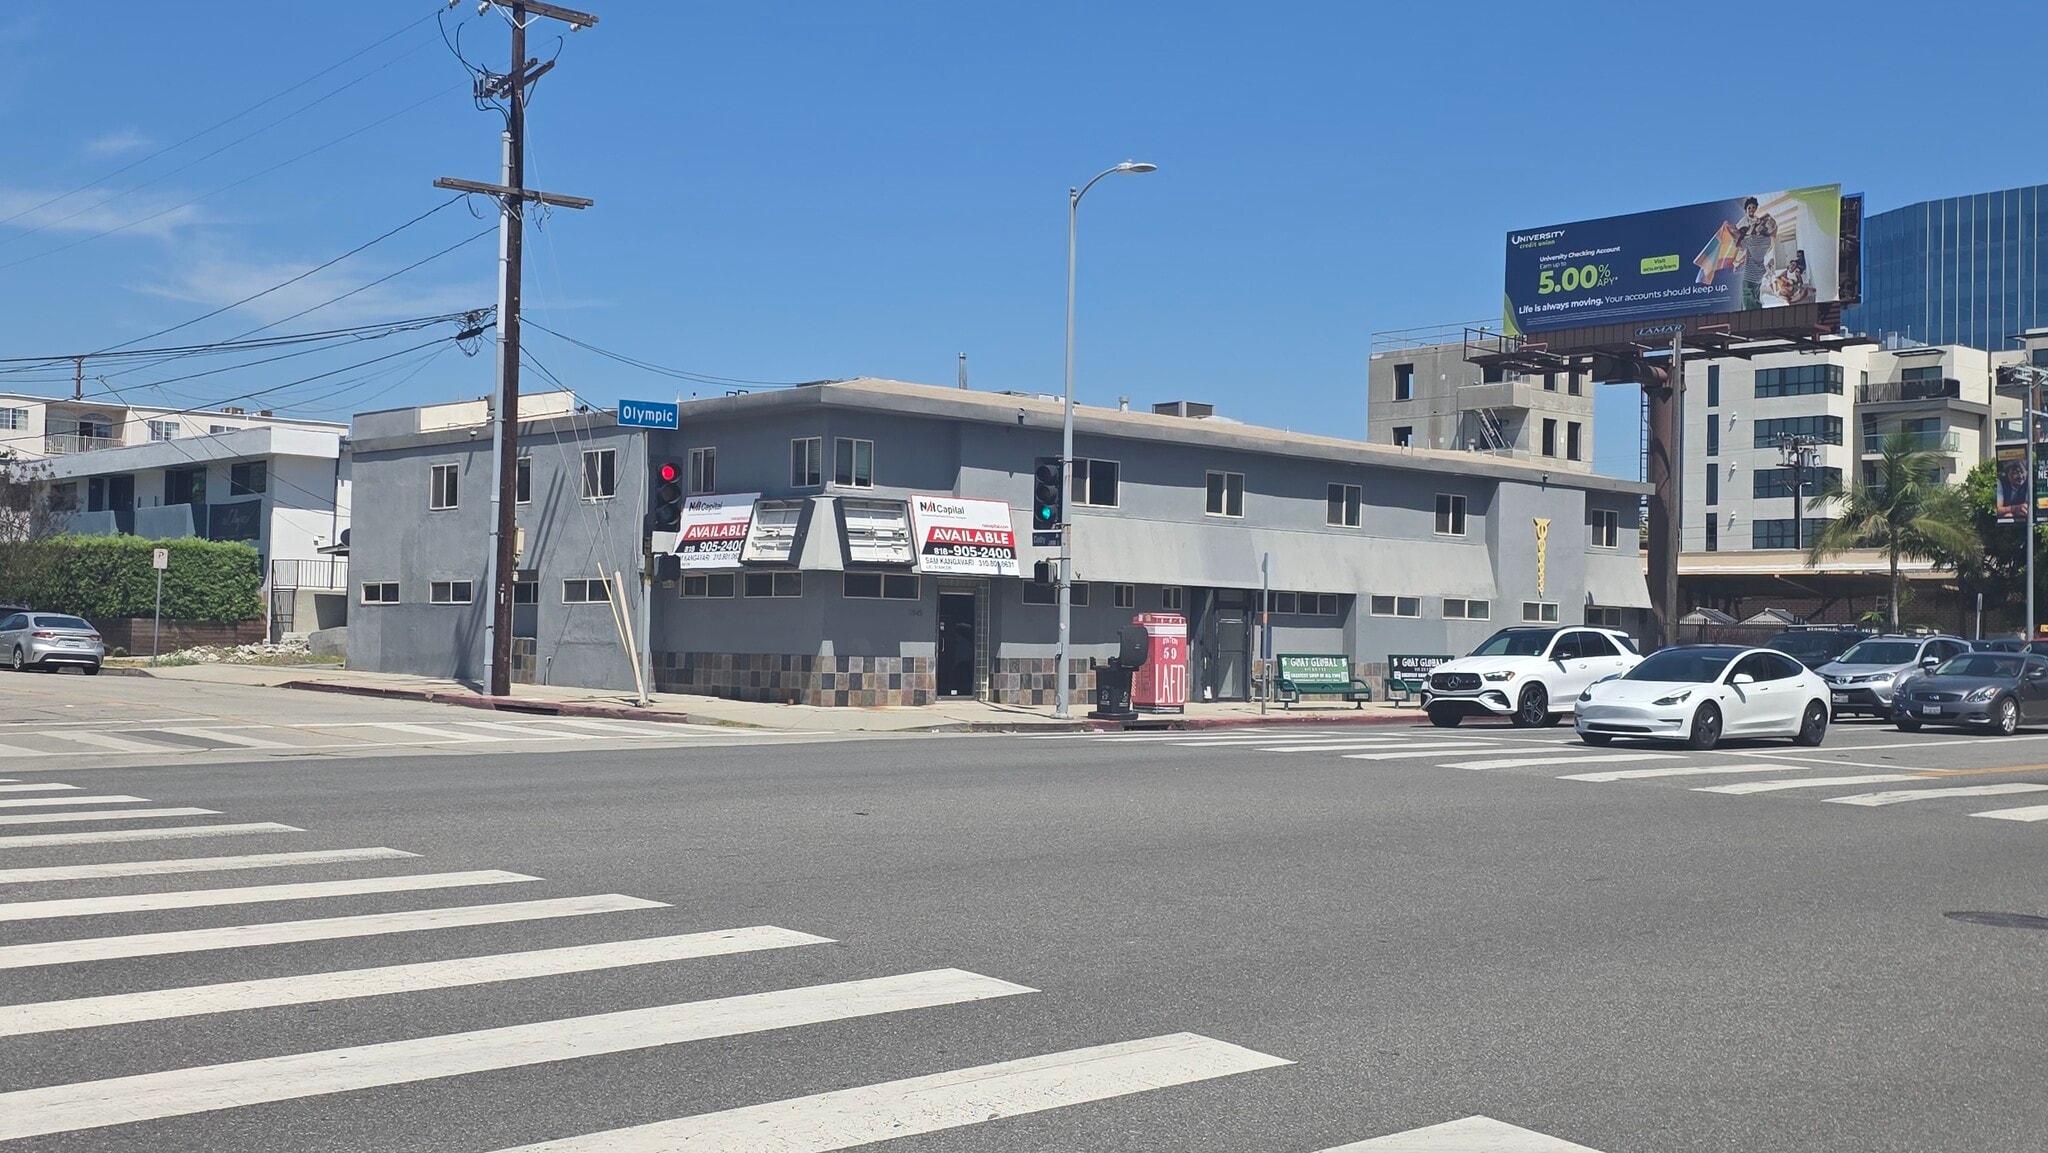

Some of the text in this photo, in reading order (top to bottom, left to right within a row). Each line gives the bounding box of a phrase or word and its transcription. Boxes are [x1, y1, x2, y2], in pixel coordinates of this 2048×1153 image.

[1511, 230, 1566, 245] UNIVERSITY
[1519, 241, 1537, 249] credit
[1539, 246, 1621, 262] University Checking Account
[1518, 304, 1533, 314] Life
[1534, 303, 1541, 312] is
[1542, 300, 1569, 311] always
[1570, 297, 1604, 308] moving.
[1604, 295, 1623, 304] Your
[1624, 290, 1662, 301] accounts
[1662, 286, 1691, 296] should
[1692, 285, 1714, 295] keep
[1715, 283, 1729, 293] up.
[1639, 324, 1682, 335] LAMAR
[623, 405, 673, 424] Olympic
[701, 501, 723, 512] Capital
[919, 501, 965, 515] NAI Capital
[688, 524, 749, 539] AVAILABLE
[933, 528, 1009, 545] AVAILABLE
[1290, 657, 1338, 667] GOAT GLOBAL
[1401, 657, 1419, 667] GOAT
[1155, 663, 1185, 704] LAFD
